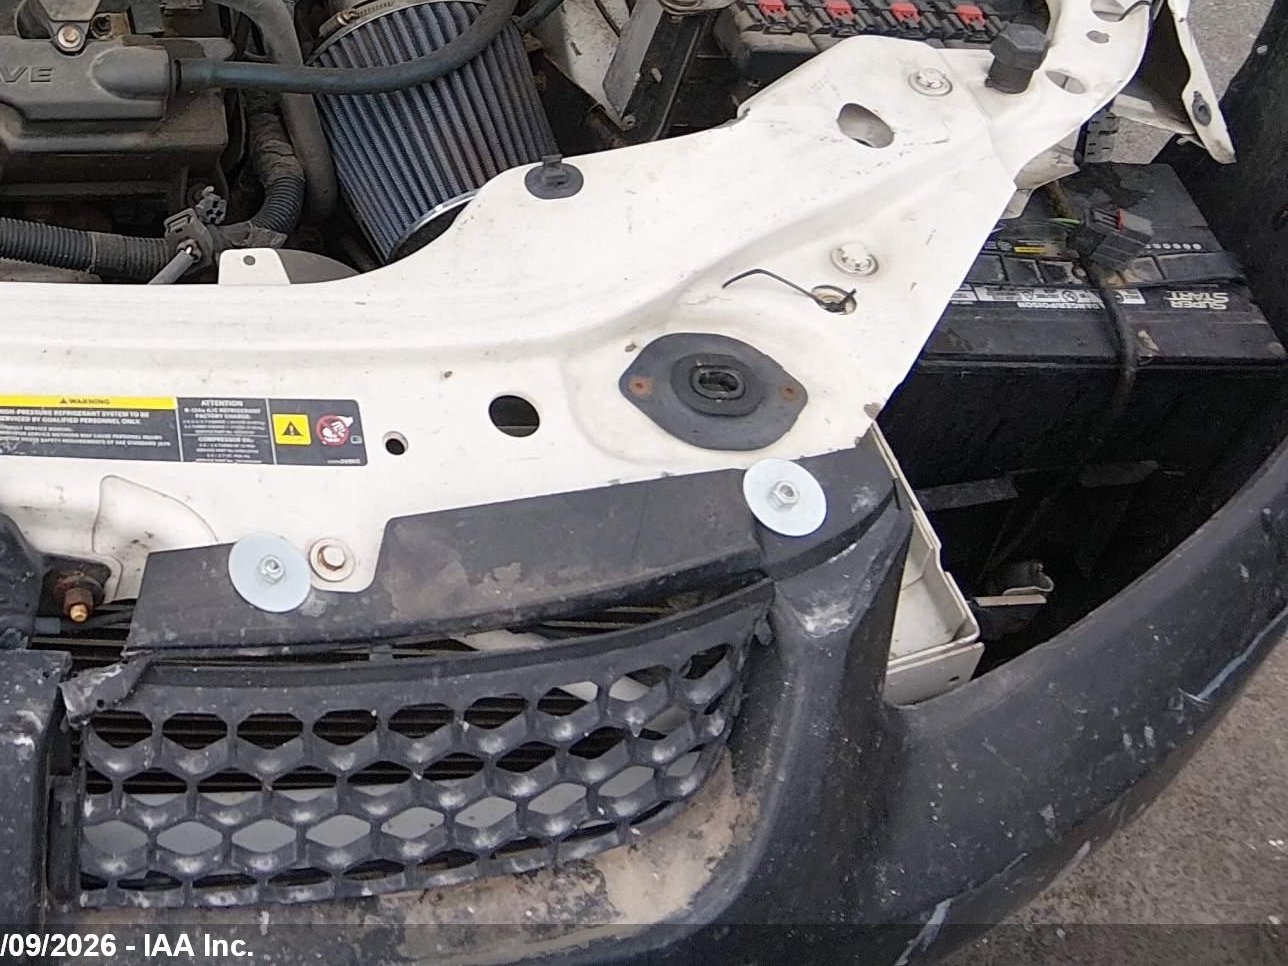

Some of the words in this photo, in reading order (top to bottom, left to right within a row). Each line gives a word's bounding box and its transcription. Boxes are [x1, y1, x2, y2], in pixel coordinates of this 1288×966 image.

[1163, 290, 1229, 302] START
[1170, 300, 1227, 310] SUPER
[201, 399, 244, 407] ATTENTION
[102, 410, 129, 418] SYSTEM
[140, 411, 150, 419] BE
